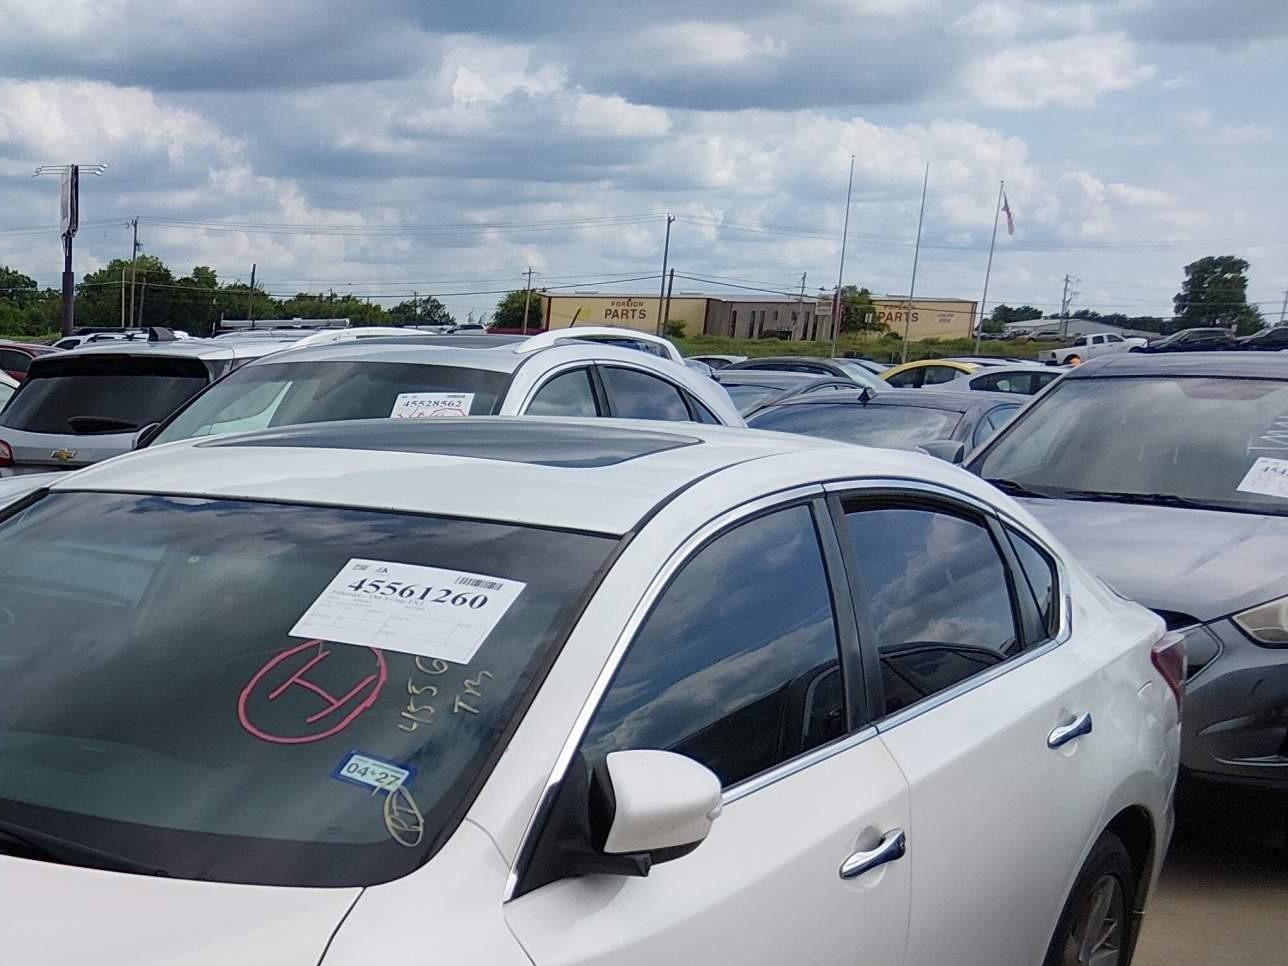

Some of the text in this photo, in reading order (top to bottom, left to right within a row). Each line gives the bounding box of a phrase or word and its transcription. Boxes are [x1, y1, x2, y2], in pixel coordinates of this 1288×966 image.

[883, 303, 915, 311] FORE
[604, 308, 647, 320] PARTS
[879, 311, 920, 323] PARTS
[402, 400, 463, 408] 45528562
[347, 577, 489, 610] 45561260
